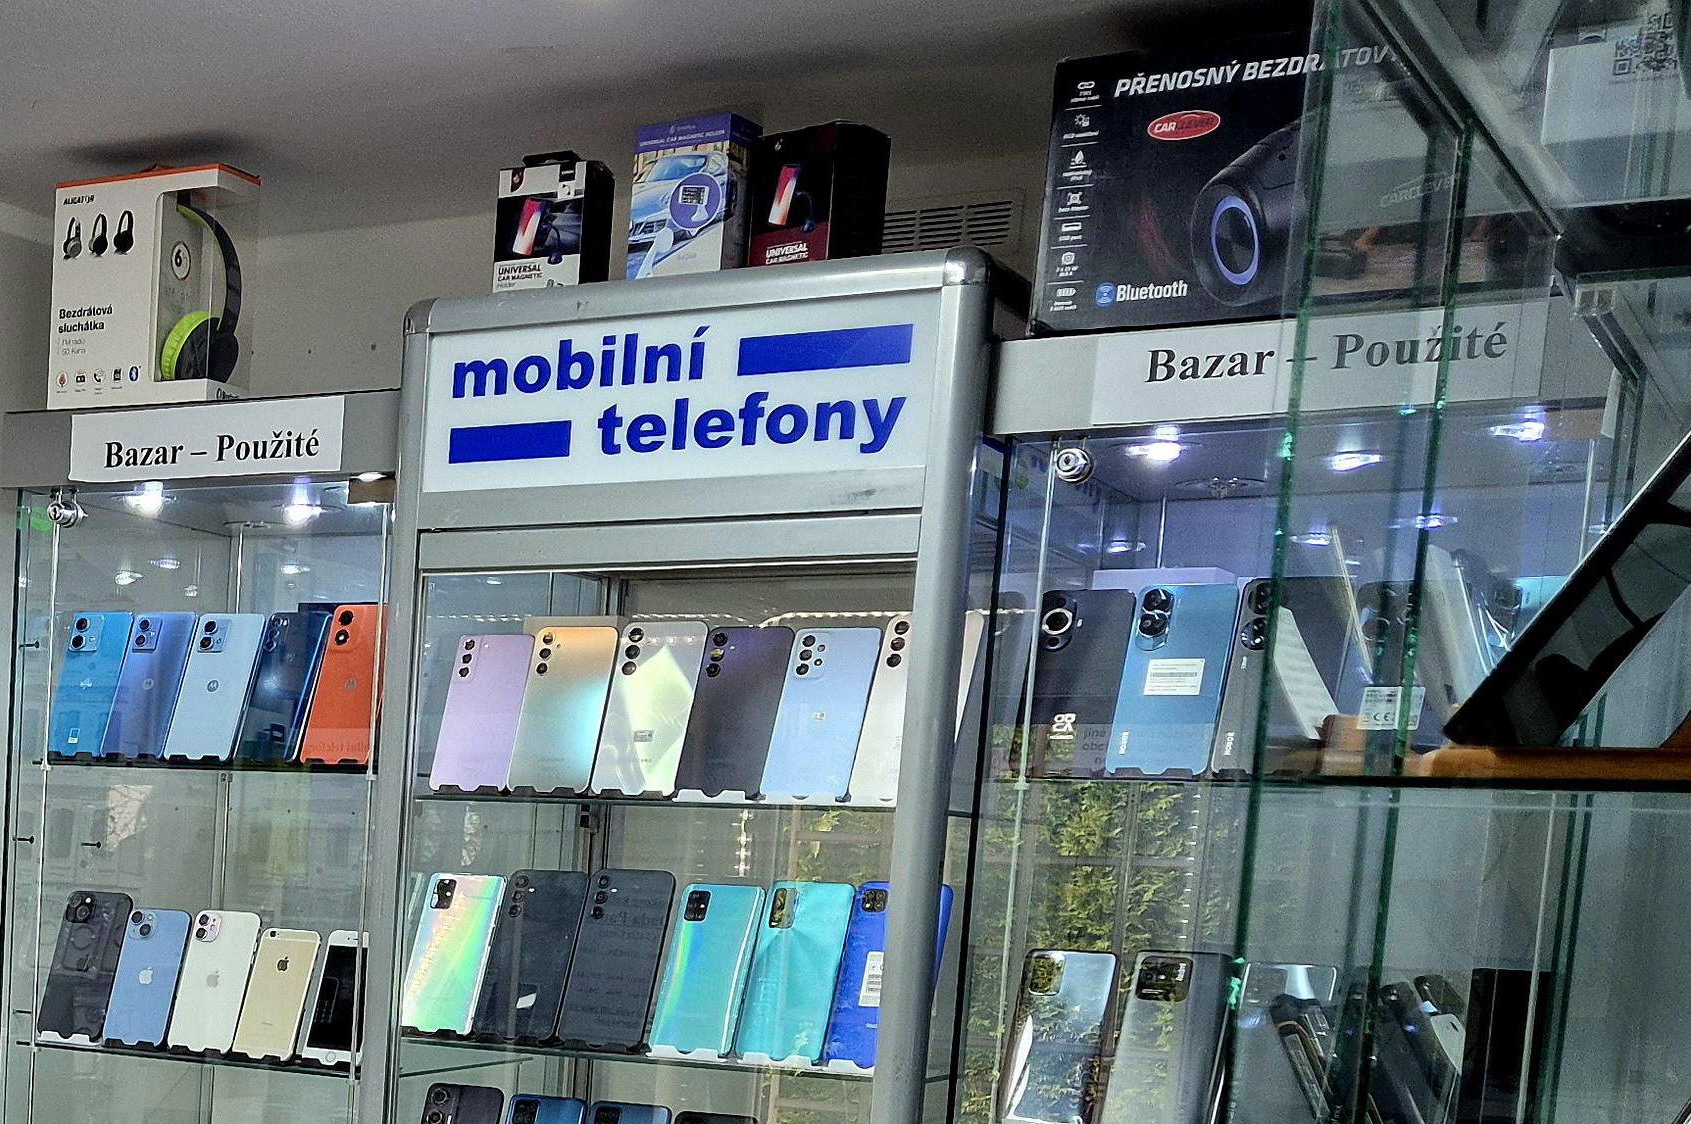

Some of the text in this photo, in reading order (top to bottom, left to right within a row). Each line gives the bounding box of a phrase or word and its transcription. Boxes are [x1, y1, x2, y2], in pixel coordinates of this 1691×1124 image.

[1114, 45, 1391, 98] PŘENOSNÝ BEZDRTOV
[766, 243, 809, 258] UNIVERSAL
[498, 264, 542, 276] UNIVERSAL
[510, 272, 543, 281] MAGNETIC
[1116, 280, 1188, 302] Bluetooth
[59, 304, 113, 320] Bezdrátová
[58, 319, 105, 334] sluchátka
[451, 325, 711, 399] mobilní
[1145, 321, 1509, 384] Bazar Použité
[597, 389, 907, 456] telefony
[103, 428, 320, 469] Bazar Použité
